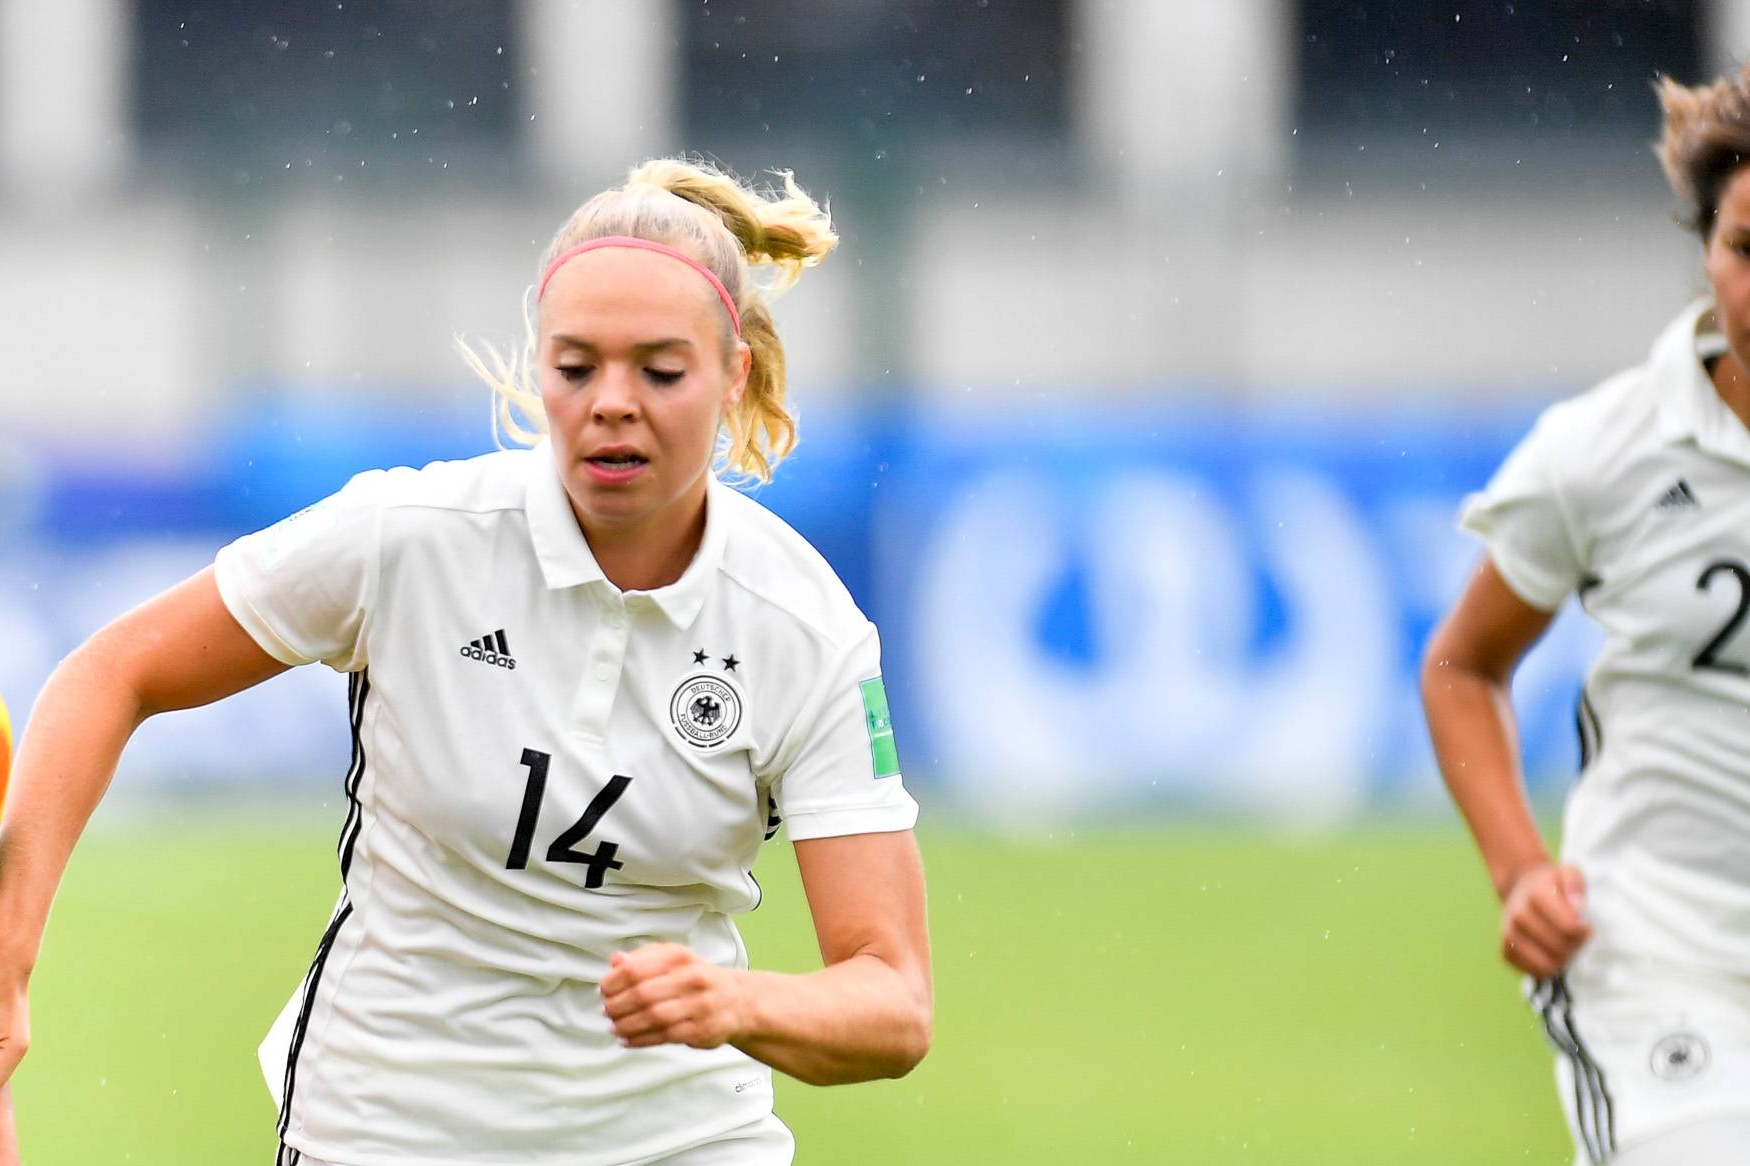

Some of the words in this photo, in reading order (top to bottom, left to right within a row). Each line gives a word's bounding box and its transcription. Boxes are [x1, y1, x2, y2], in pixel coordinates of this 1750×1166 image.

[1692, 559, 1750, 674] 2
[460, 645, 517, 670] adidas
[690, 684, 731, 702] DEUTSCHER
[506, 747, 633, 889] 14
